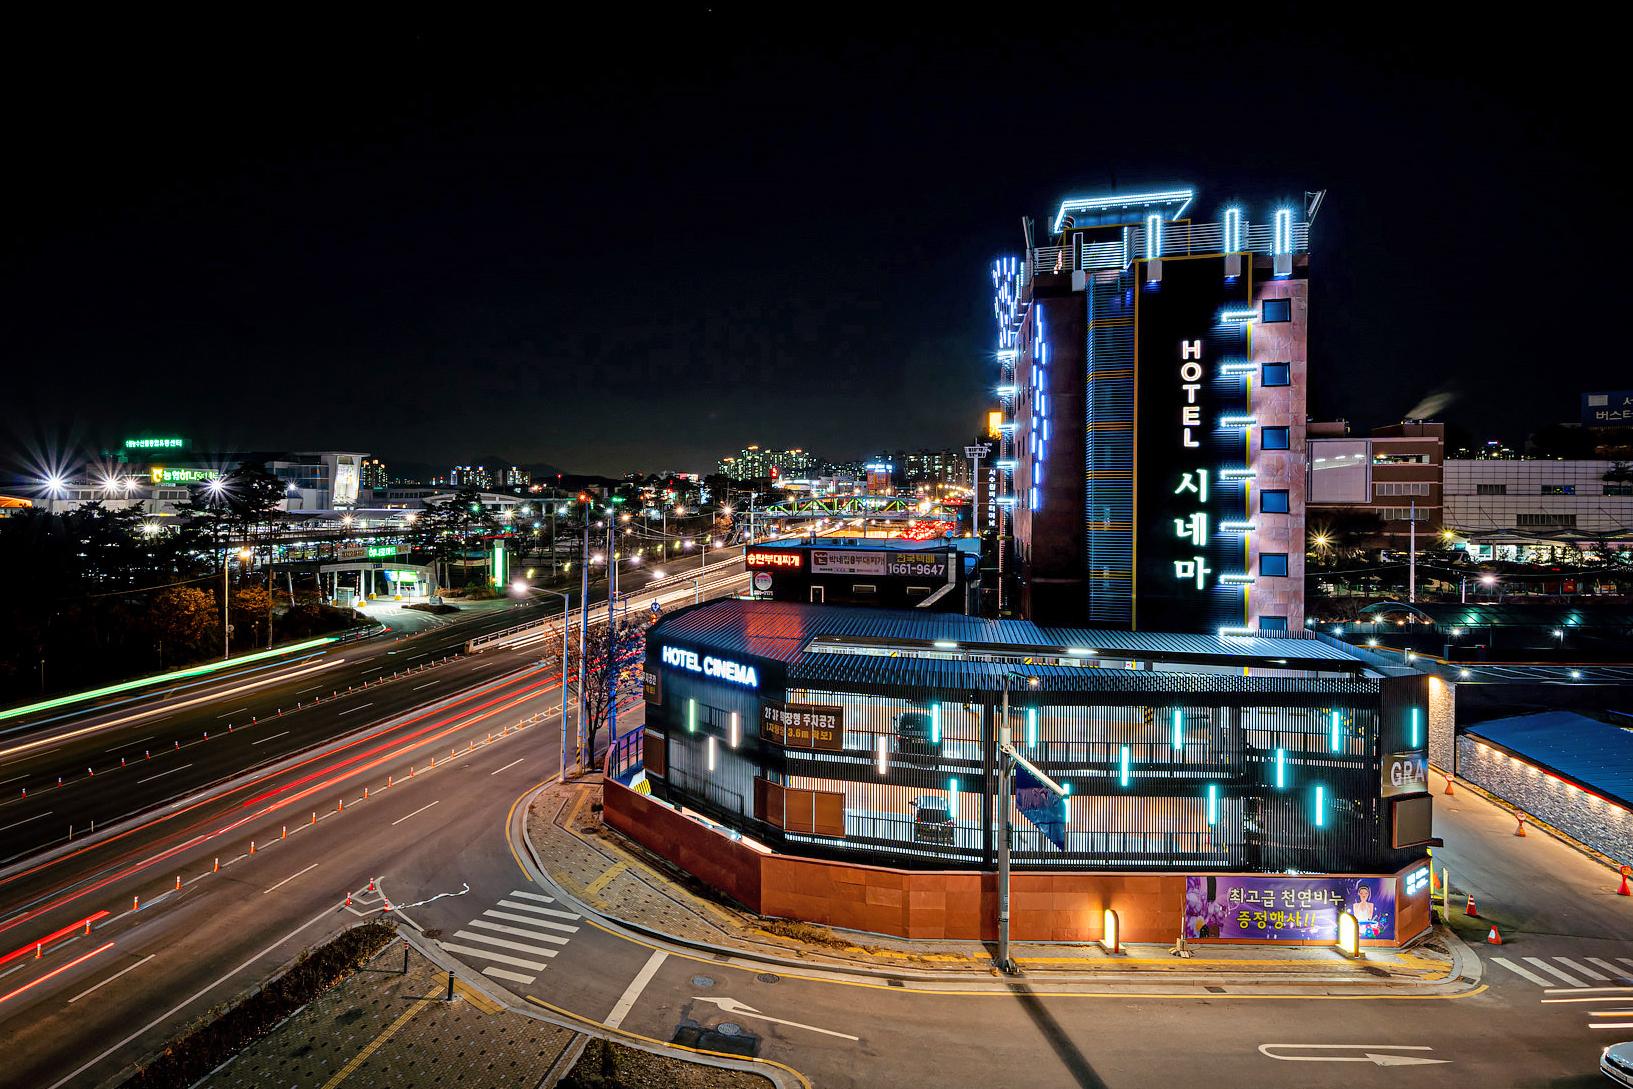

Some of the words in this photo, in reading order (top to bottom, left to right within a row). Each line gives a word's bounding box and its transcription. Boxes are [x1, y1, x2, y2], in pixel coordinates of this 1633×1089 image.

[1180, 340, 1202, 448] HOTEL
[1174, 468, 1212, 590] 시네마
[747, 553, 800, 567] 송탄부대찌개
[888, 563, 945, 576] 1661-9647
[662, 645, 703, 672] HOTEL
[703, 656, 758, 687] CINEMA
[803, 713, 836, 728] 주차공간
[1230, 887, 1276, 908] 최고급
[1281, 888, 1345, 908] 천연비누
[1237, 910, 1317, 930] 증정행사!!
